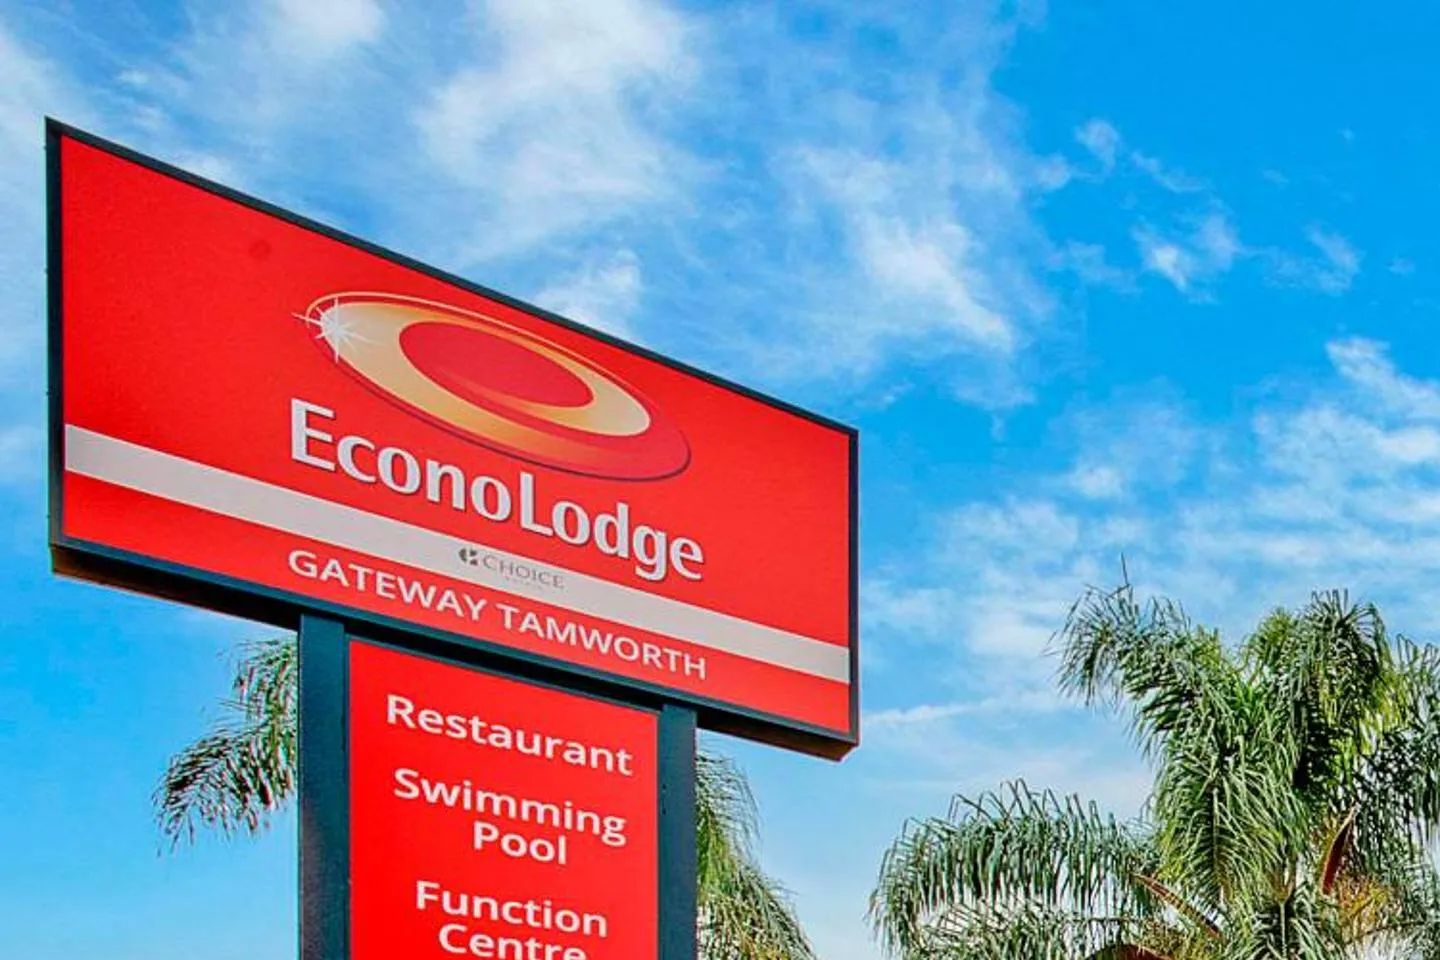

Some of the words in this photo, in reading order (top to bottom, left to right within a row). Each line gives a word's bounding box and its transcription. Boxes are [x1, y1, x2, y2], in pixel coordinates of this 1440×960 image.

[290, 397, 704, 583] EconoLodge
[482, 554, 566, 589] CHOICE
[288, 549, 487, 622] GATEWAY
[496, 602, 707, 681] TAMWORTH
[386, 694, 633, 776] Restaurant
[393, 768, 628, 847] Swimming
[473, 821, 567, 865] Pool
[415, 880, 608, 938] Function
